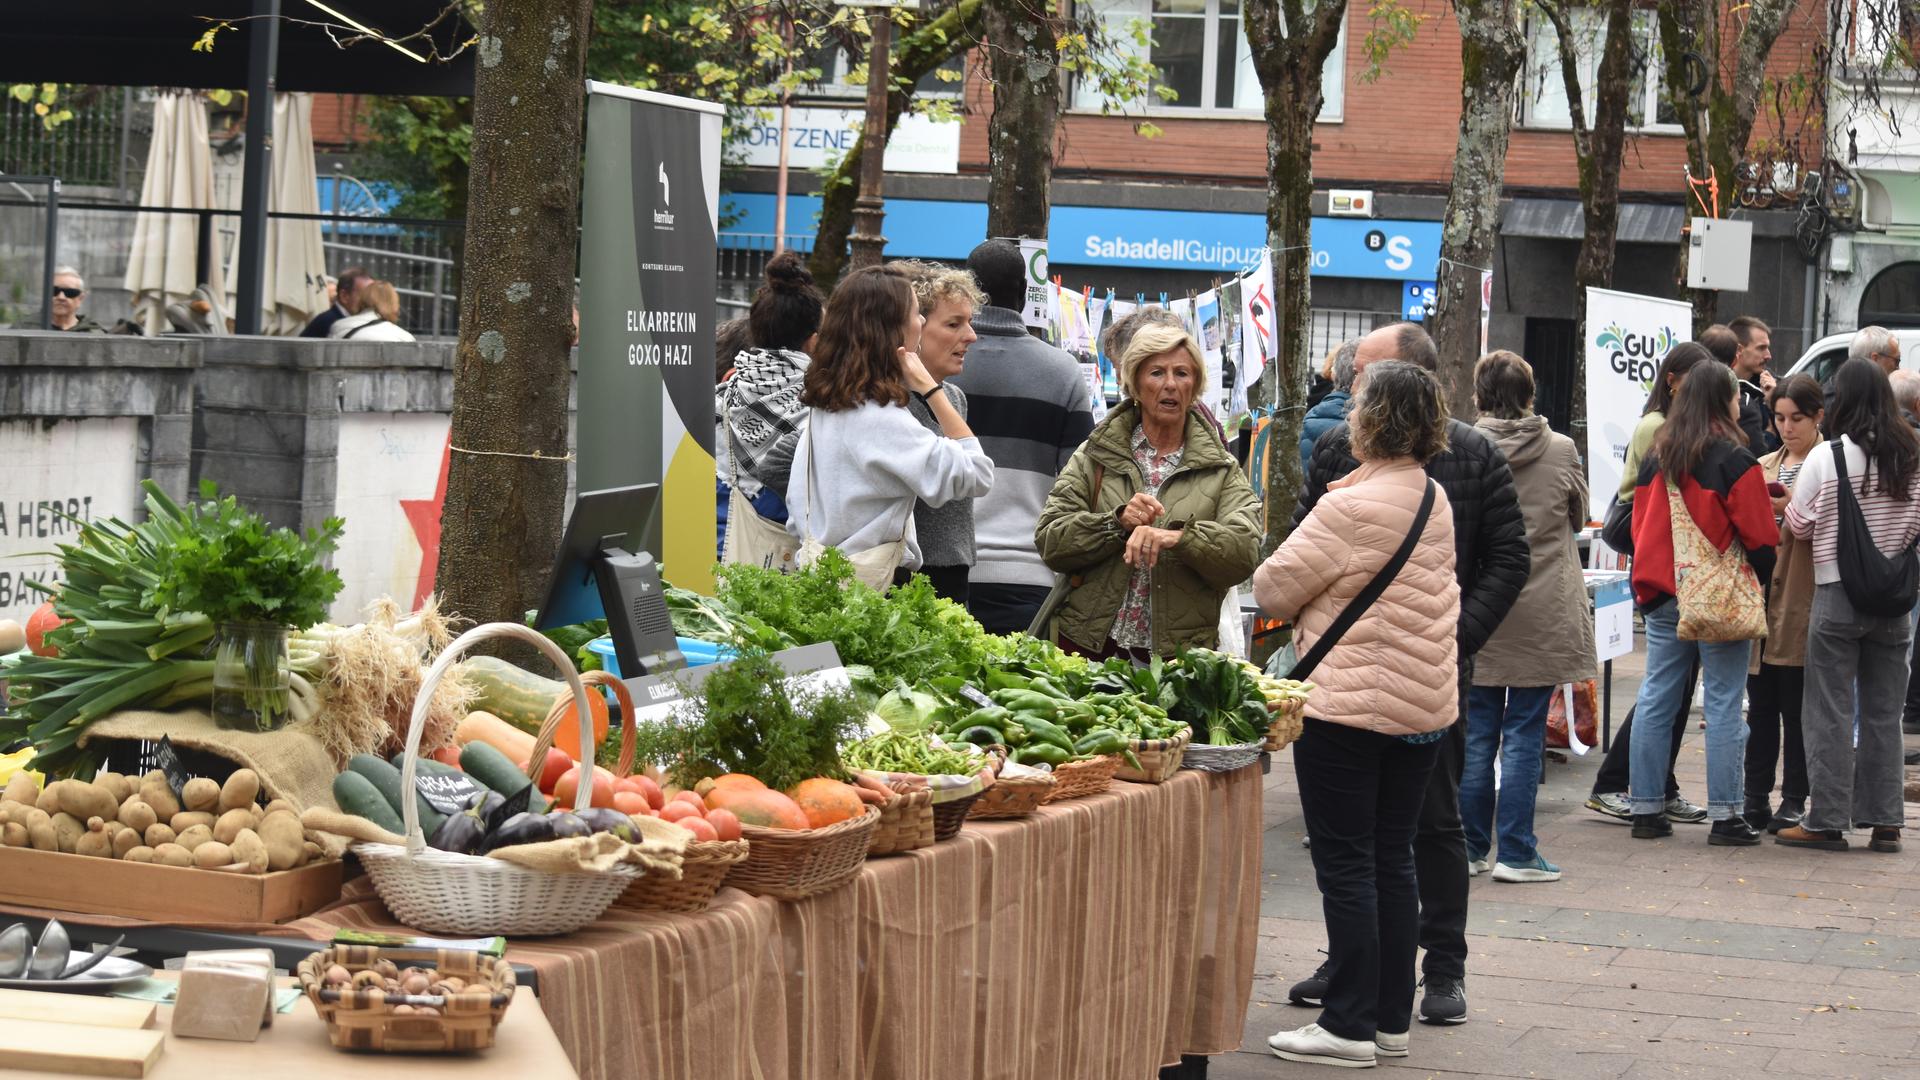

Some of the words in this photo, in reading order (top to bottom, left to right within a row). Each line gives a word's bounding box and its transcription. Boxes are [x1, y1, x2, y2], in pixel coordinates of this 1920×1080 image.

[1085, 235, 1330, 268] SabadellGuipuzo
[627, 310, 696, 333] ELKARREKIN
[628, 343, 661, 366] GOXO
[664, 344, 692, 366] HAZI
[1624, 333, 1655, 359] GU
